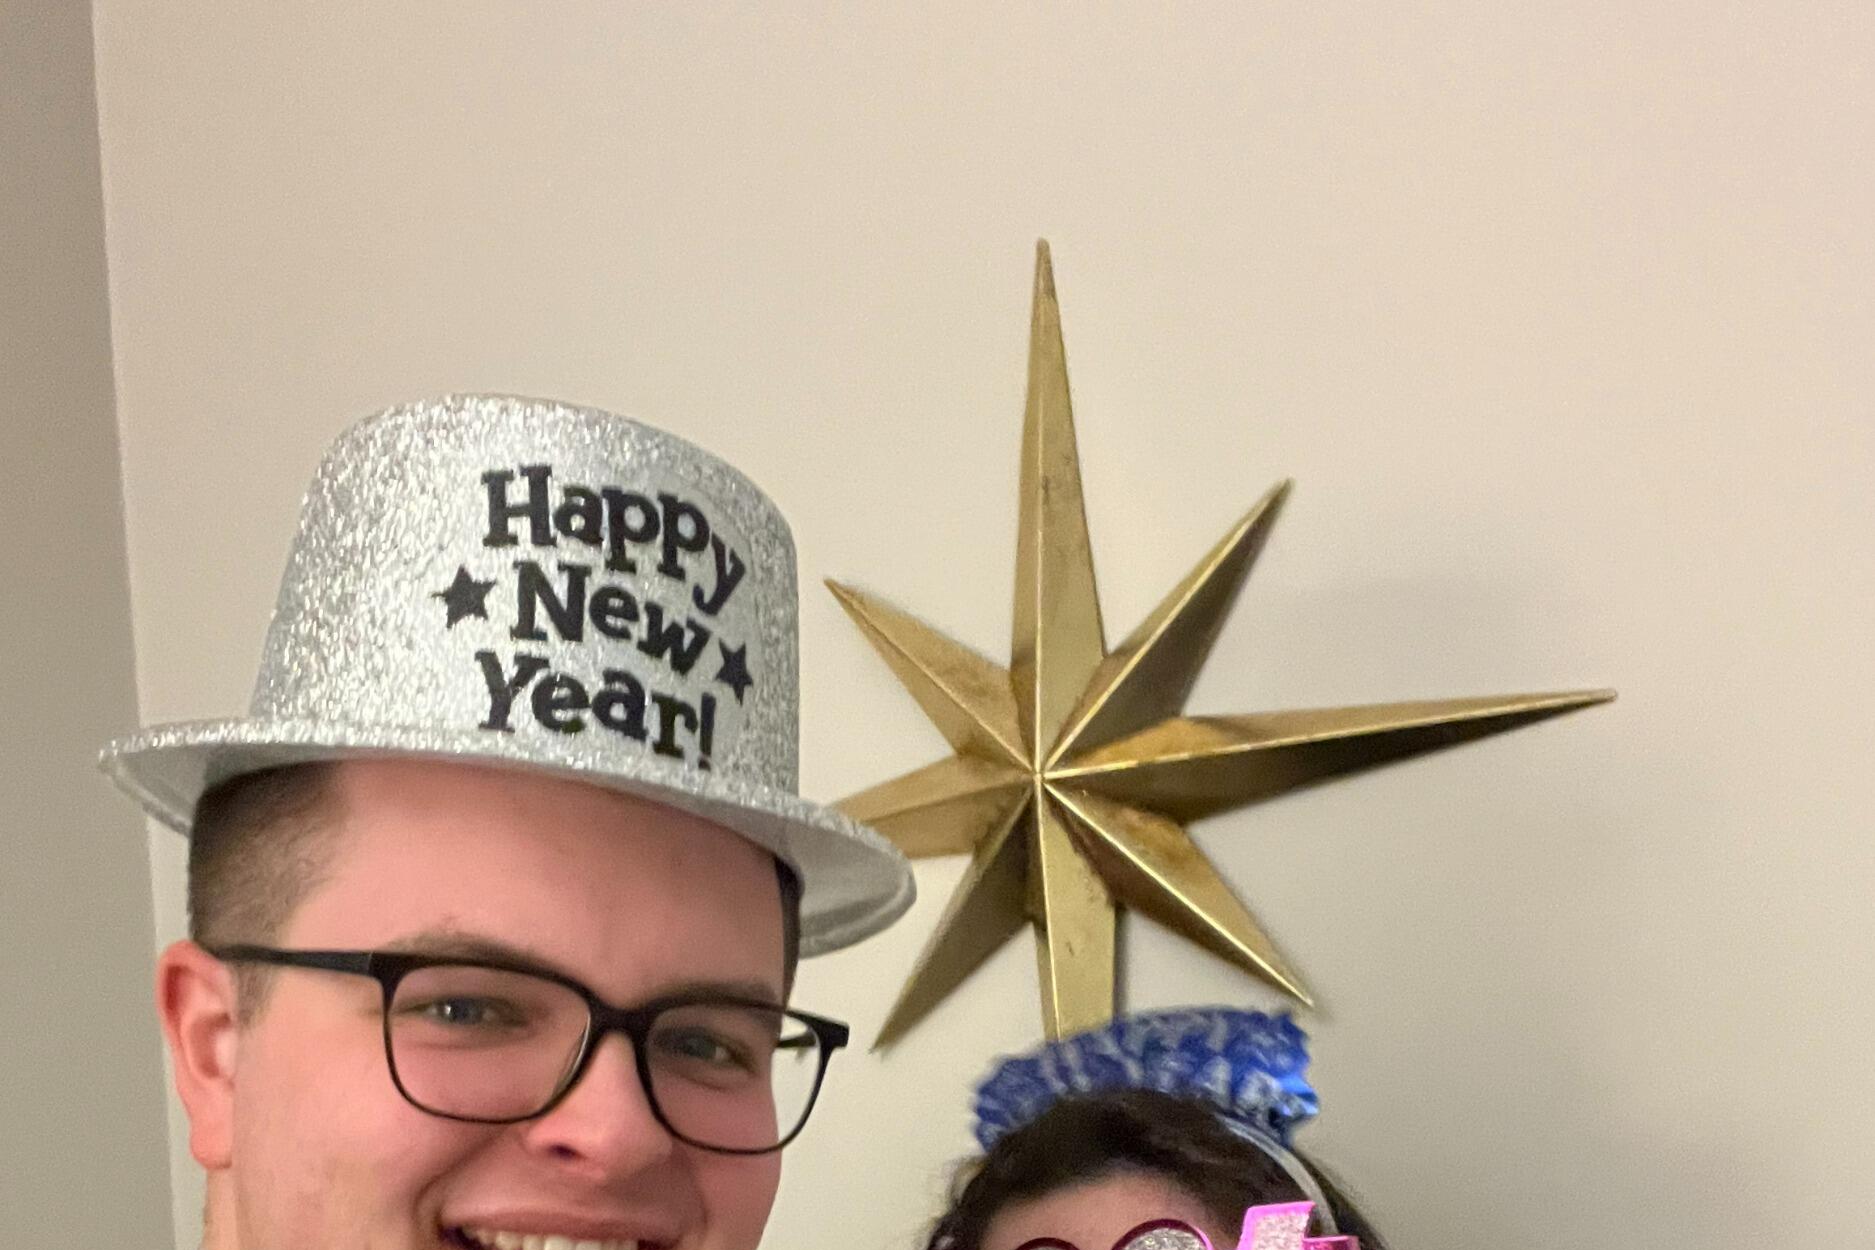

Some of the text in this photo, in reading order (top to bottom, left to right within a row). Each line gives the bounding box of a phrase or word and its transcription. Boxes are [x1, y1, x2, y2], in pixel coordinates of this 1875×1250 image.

[481, 463, 746, 616] Happy
[510, 560, 713, 676] New
[475, 650, 717, 772] Year!
